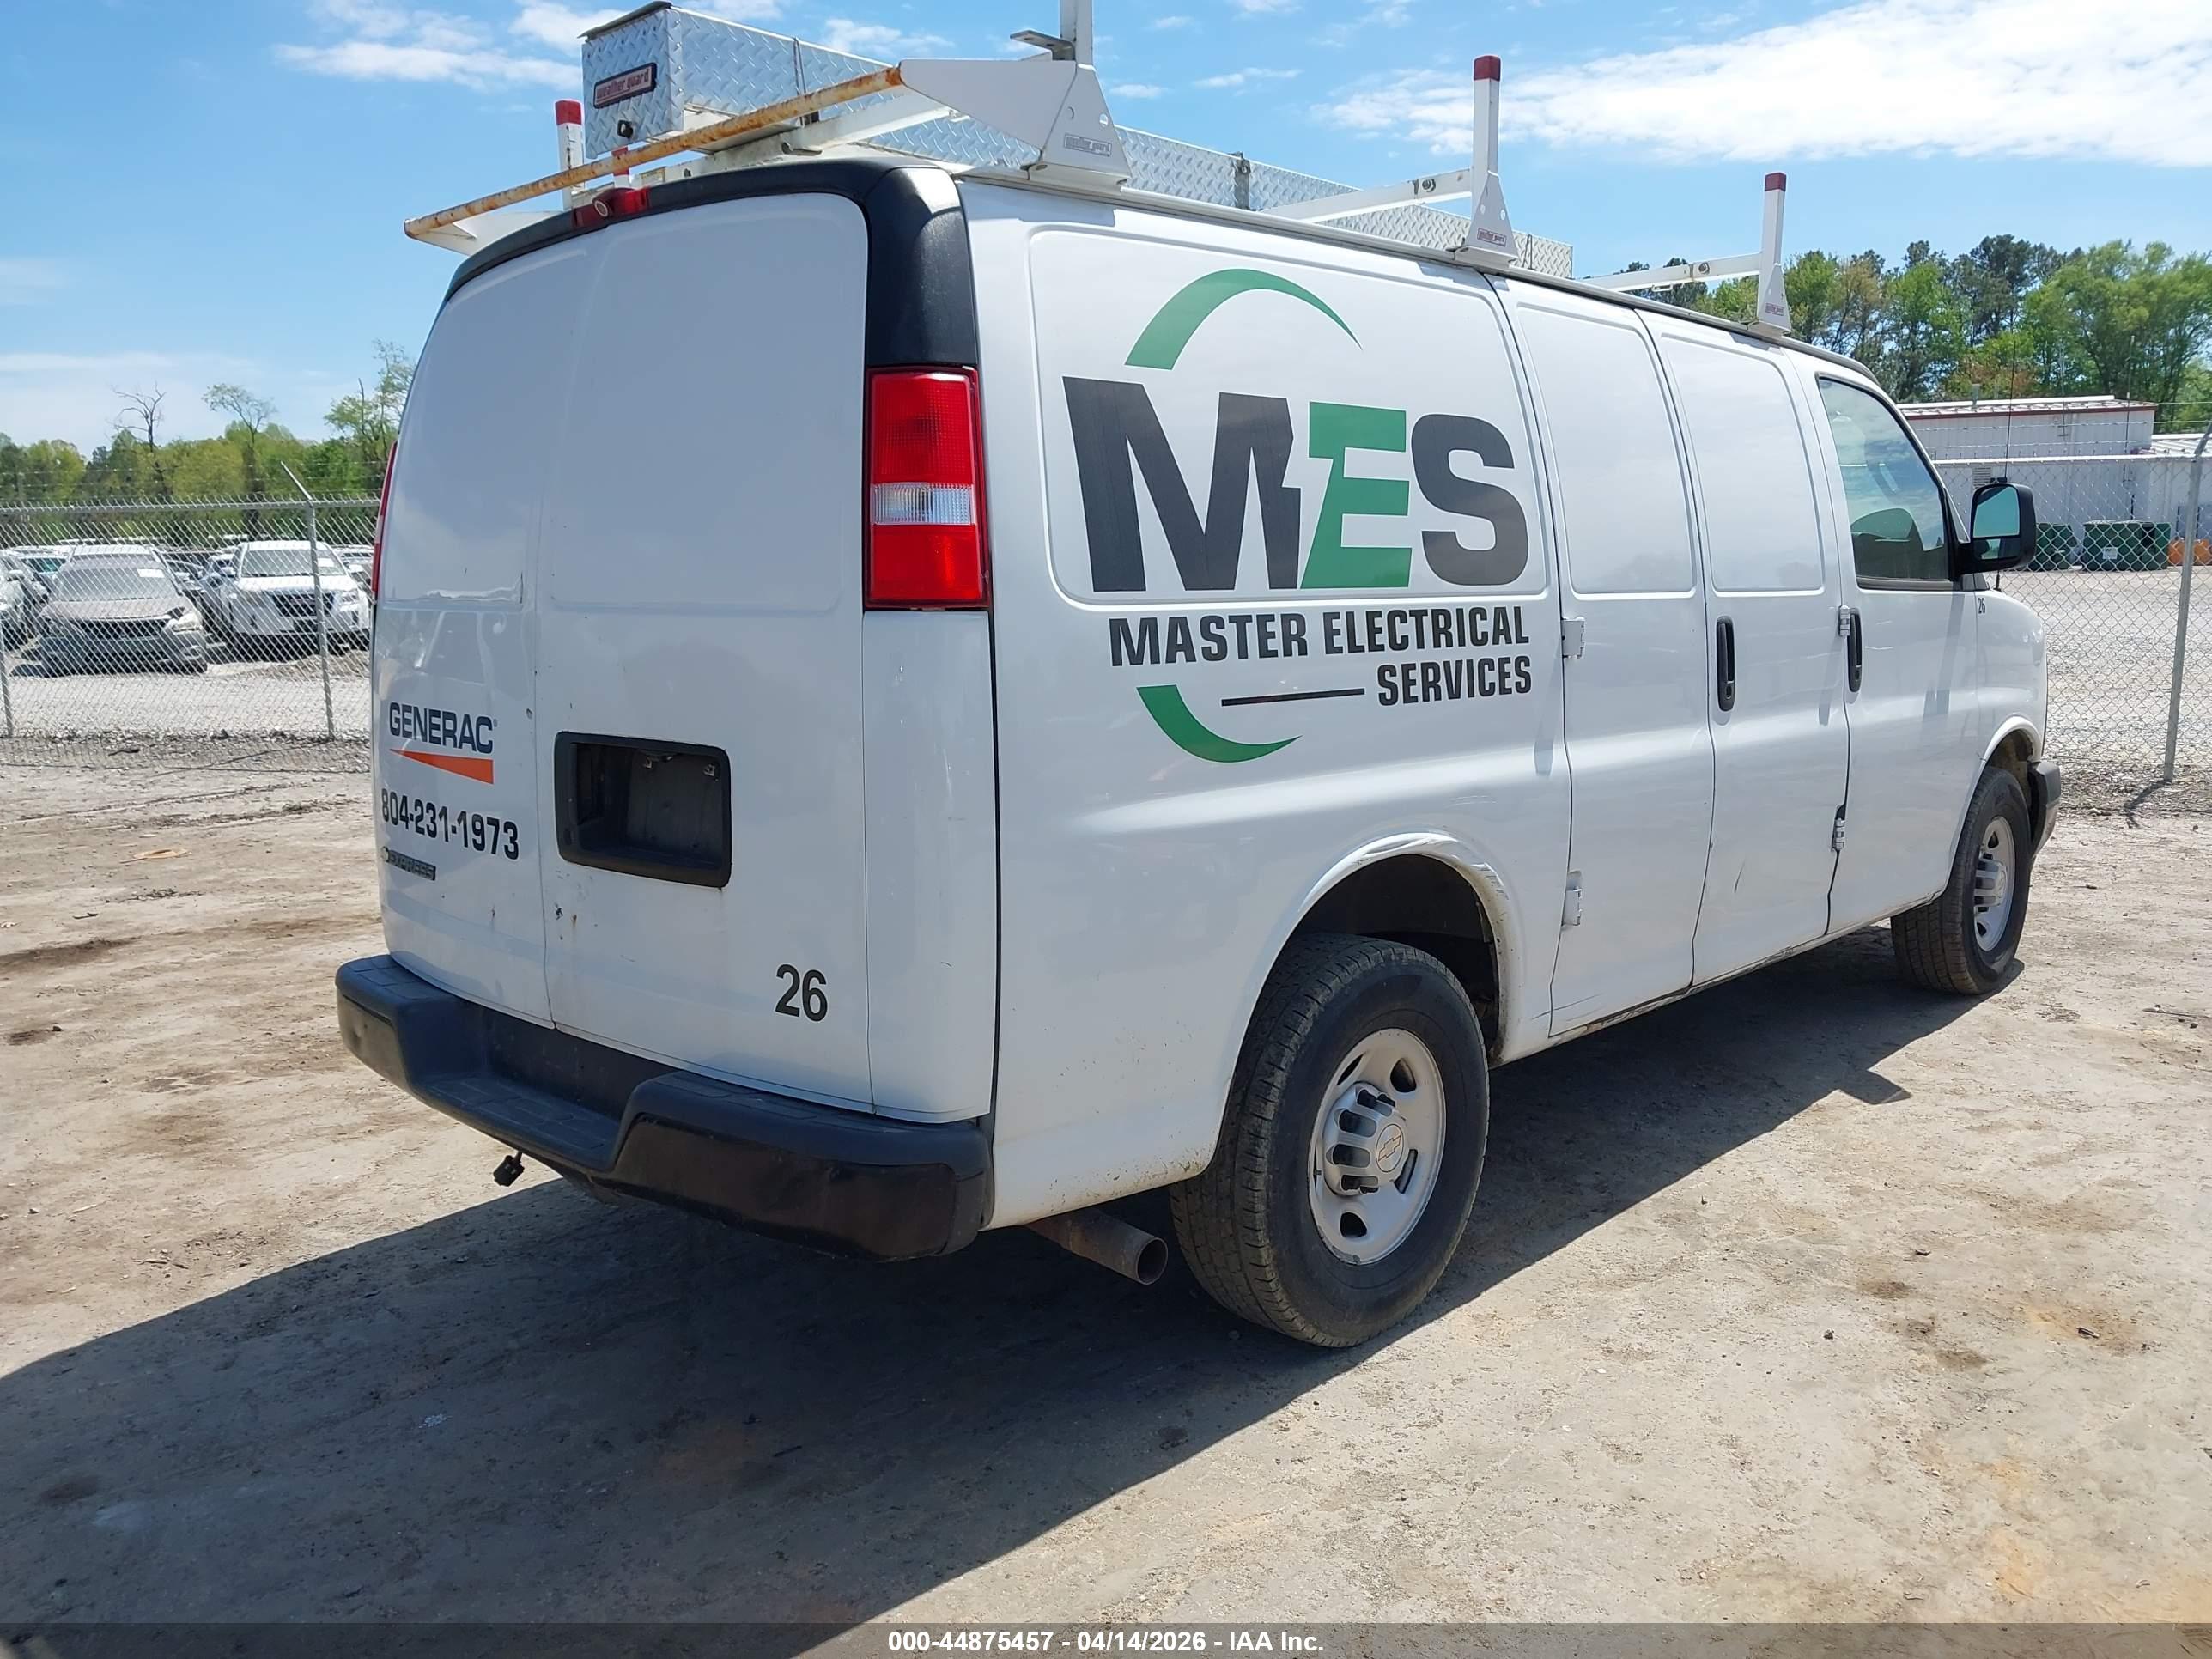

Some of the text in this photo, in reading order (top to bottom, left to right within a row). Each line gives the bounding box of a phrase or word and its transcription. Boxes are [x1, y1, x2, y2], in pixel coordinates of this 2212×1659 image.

[1062, 376, 1529, 592] MES
[1977, 597, 1986, 614] 26
[1109, 605, 1530, 667] MASTER ELECTRICAL
[1376, 655, 1533, 707] SERVICES
[389, 702, 494, 754] GENERAC
[381, 787, 520, 860] 804-231-1973
[775, 963, 828, 1022] 26
